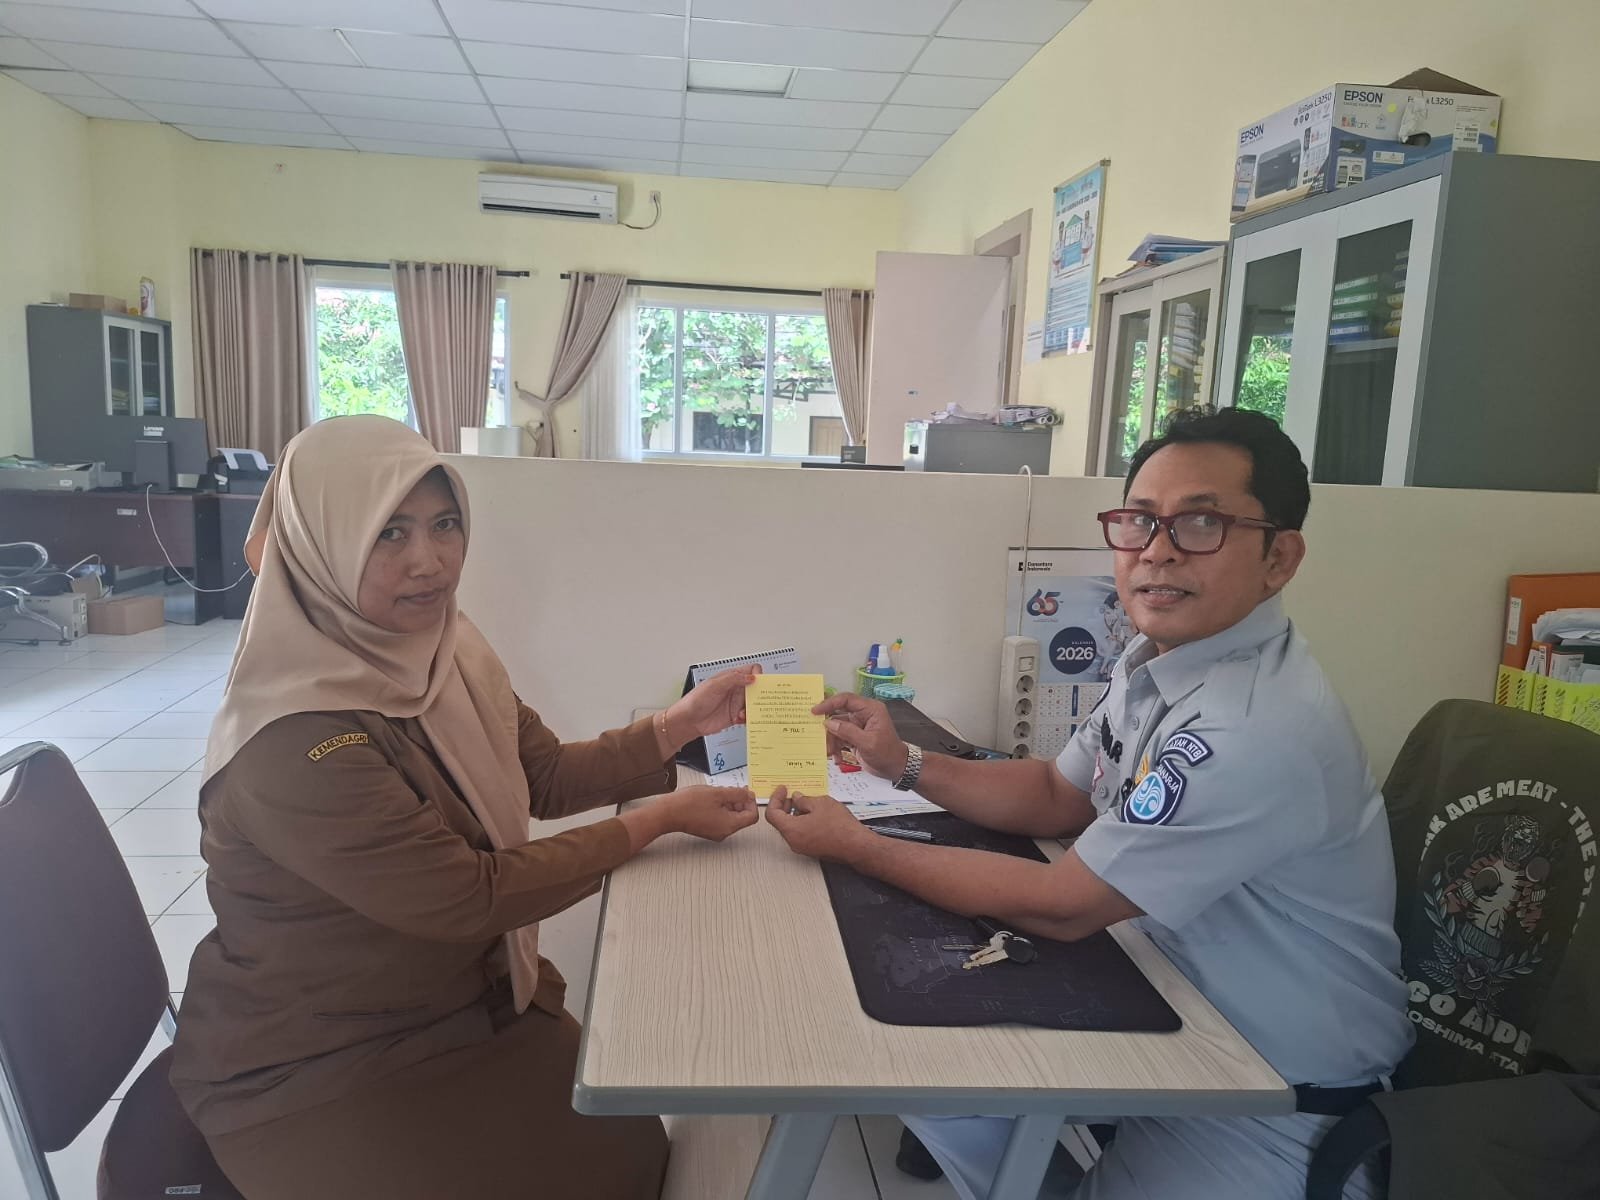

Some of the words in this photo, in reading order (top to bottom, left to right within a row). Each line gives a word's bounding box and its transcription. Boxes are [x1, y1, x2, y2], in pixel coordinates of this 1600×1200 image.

[1314, 92, 1332, 107] L3250
[1343, 90, 1383, 104] EPSON
[1431, 96, 1454, 106] L3250
[1240, 123, 1264, 144] EPSON
[1026, 588, 1061, 617] 65
[1056, 647, 1094, 661] 2026
[310, 734, 367, 759] KEMENDAGRI
[1186, 742, 1202, 757] NTB
[1445, 786, 1494, 821] ARE
[1496, 779, 1558, 802] MEAT
[1568, 805, 1598, 862] THE
